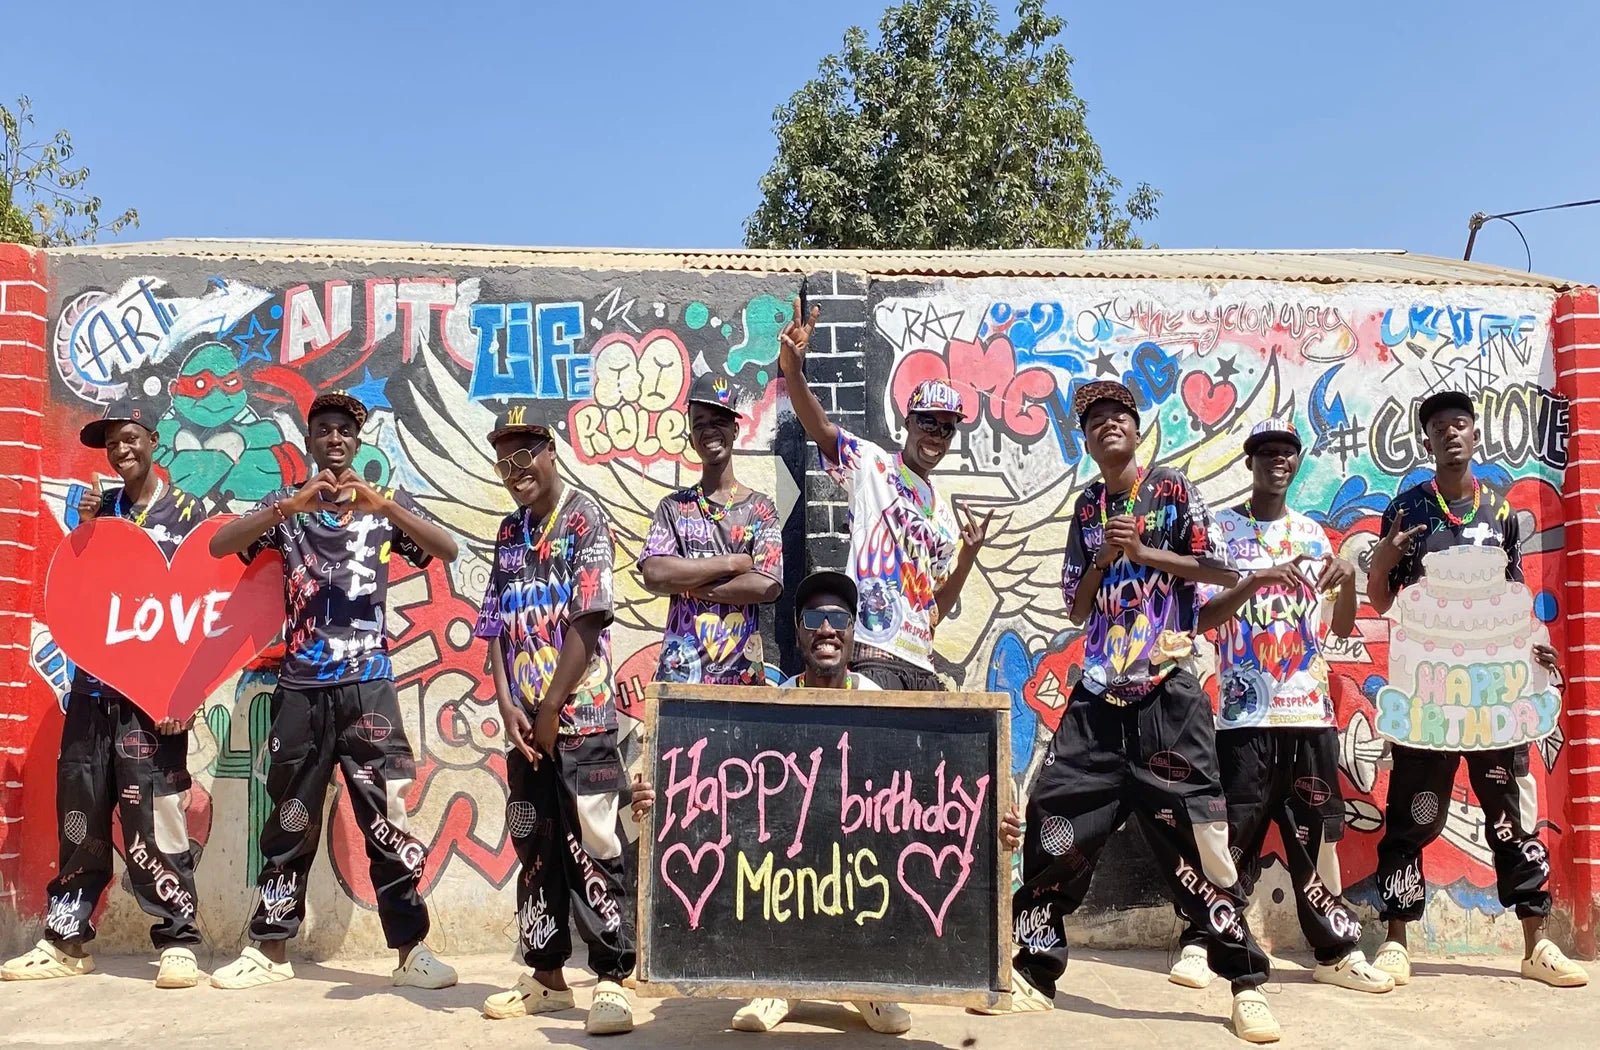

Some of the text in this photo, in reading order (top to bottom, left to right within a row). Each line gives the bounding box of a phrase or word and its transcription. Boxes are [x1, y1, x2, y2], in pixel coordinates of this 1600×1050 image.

[80, 278, 171, 379] ART
[105, 588, 233, 645] LOVE
[1416, 662, 1528, 706] HAPPY
[658, 731, 990, 860] Happy birthday
